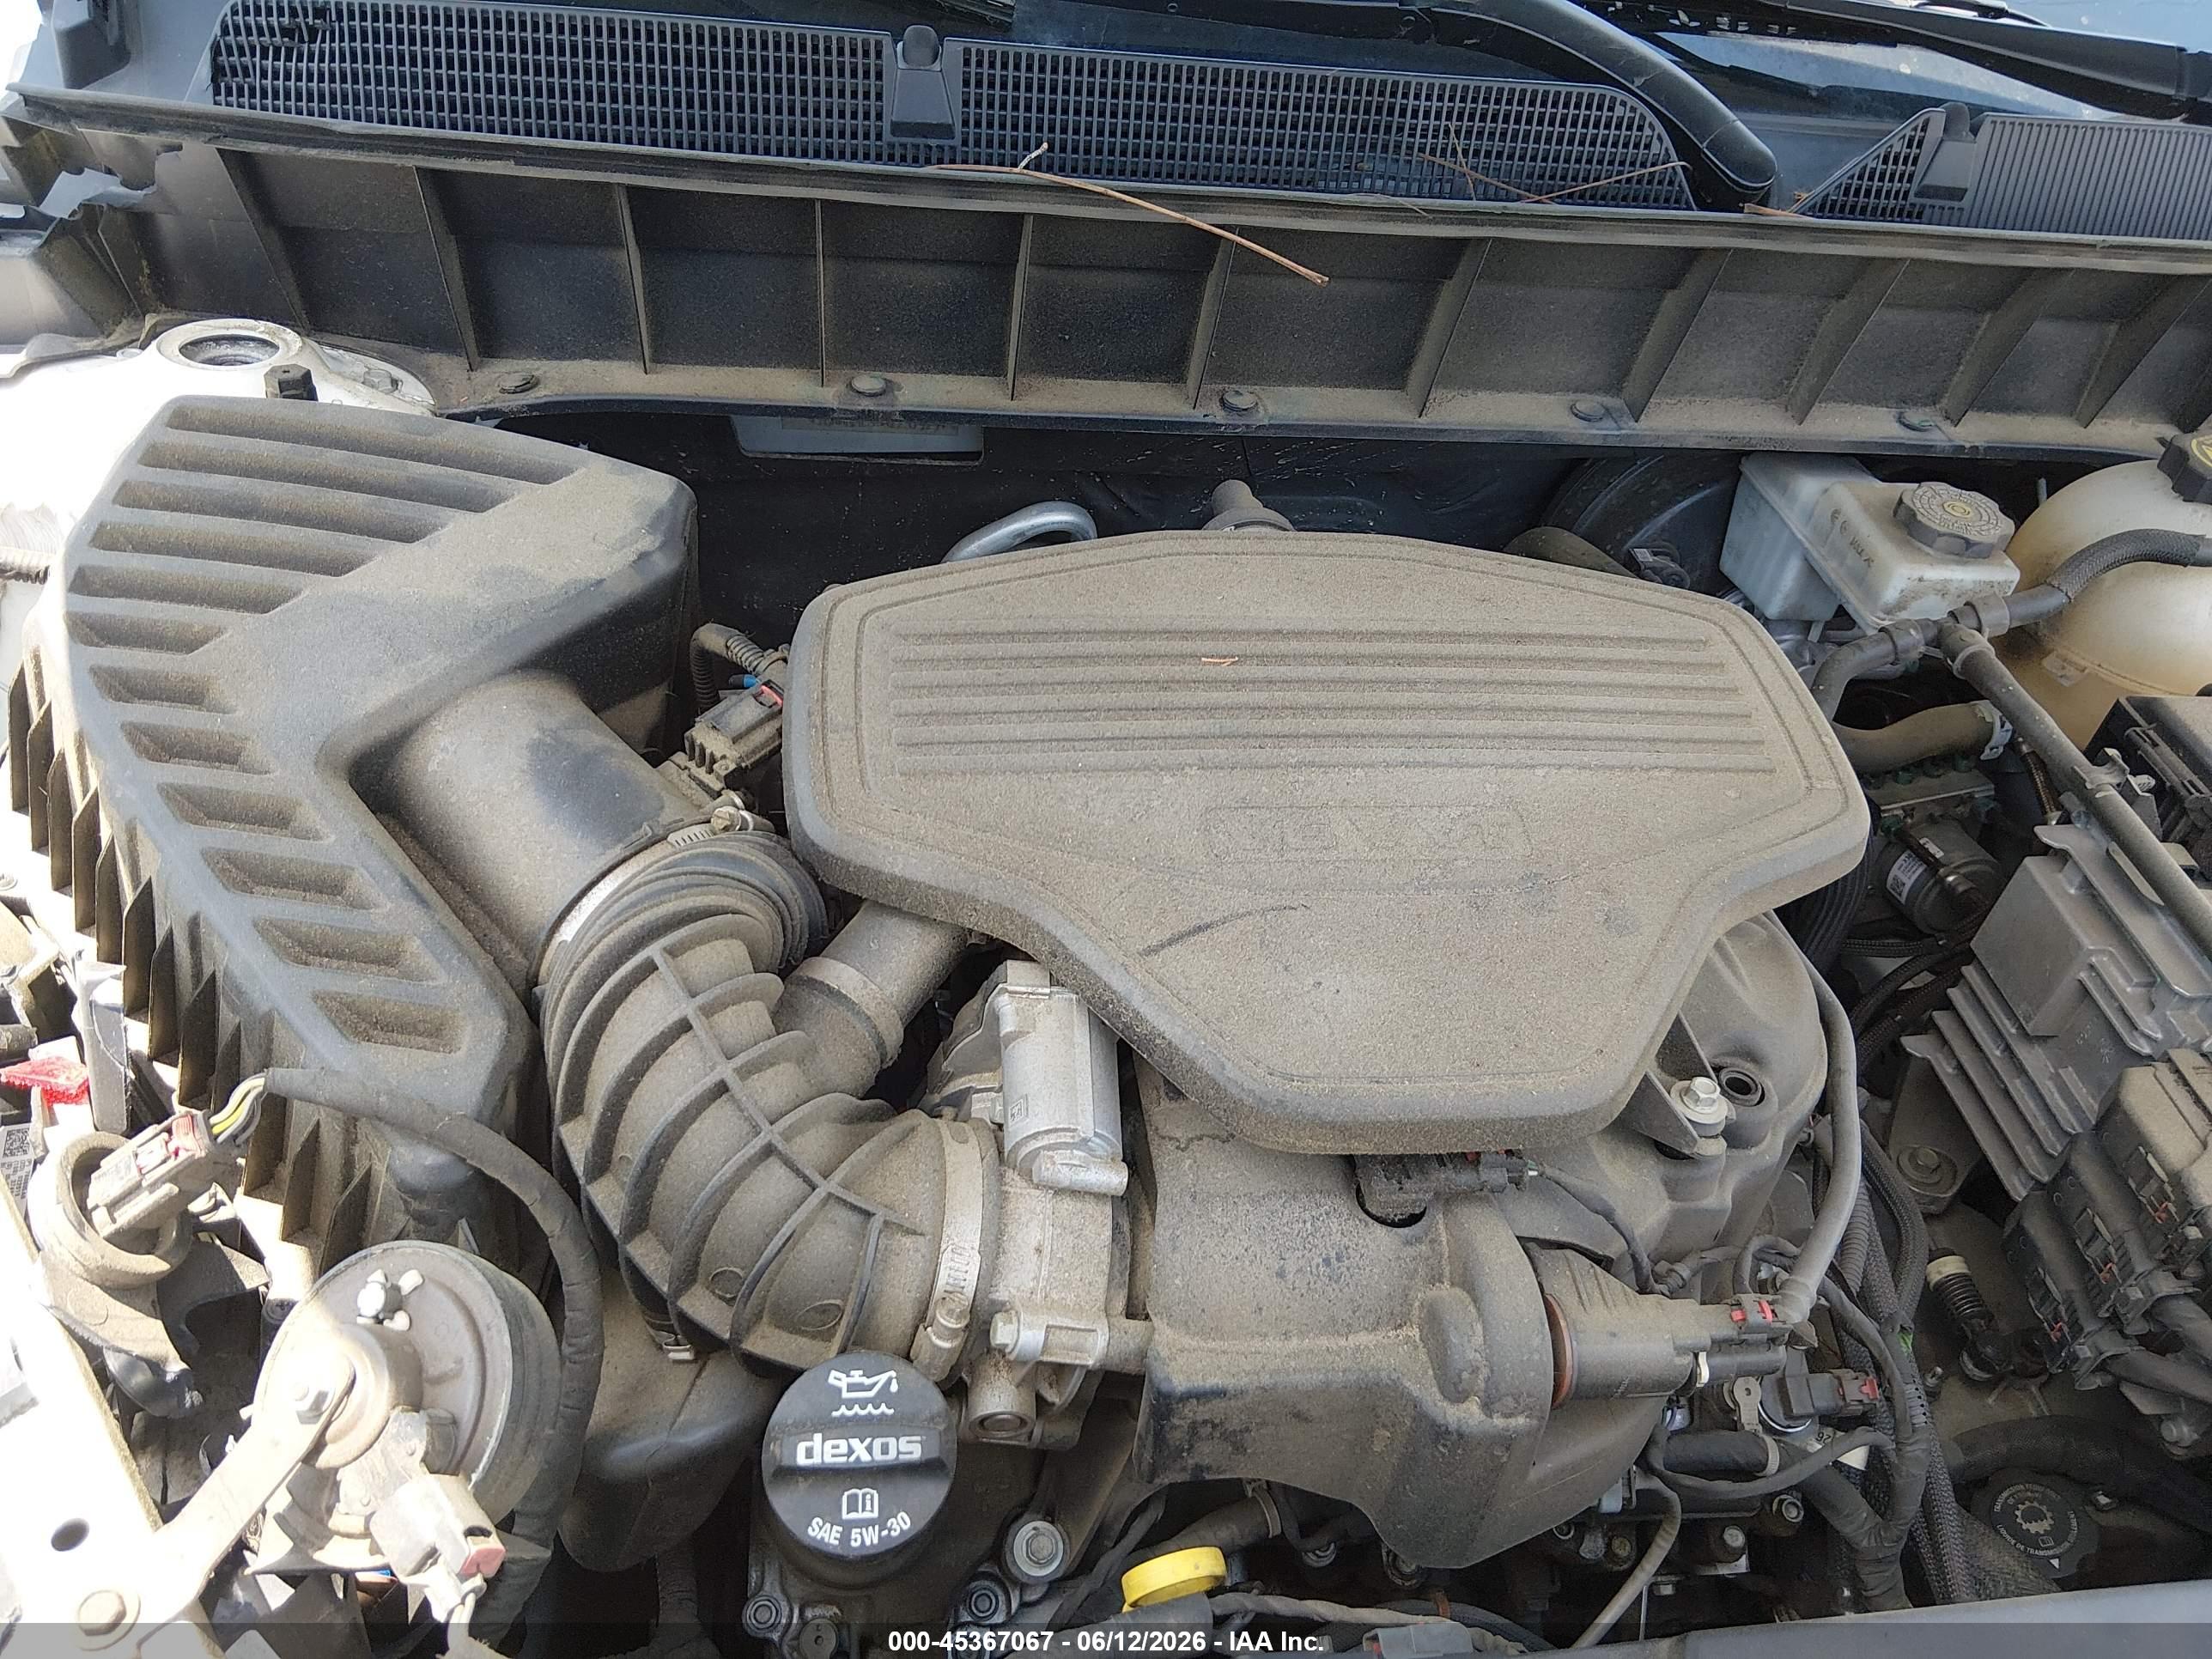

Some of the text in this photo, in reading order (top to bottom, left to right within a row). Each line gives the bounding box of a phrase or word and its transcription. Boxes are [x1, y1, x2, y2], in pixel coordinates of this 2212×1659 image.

[797, 1432, 922, 1466] dexos
[807, 1510, 911, 1547] SAE 5W-30
